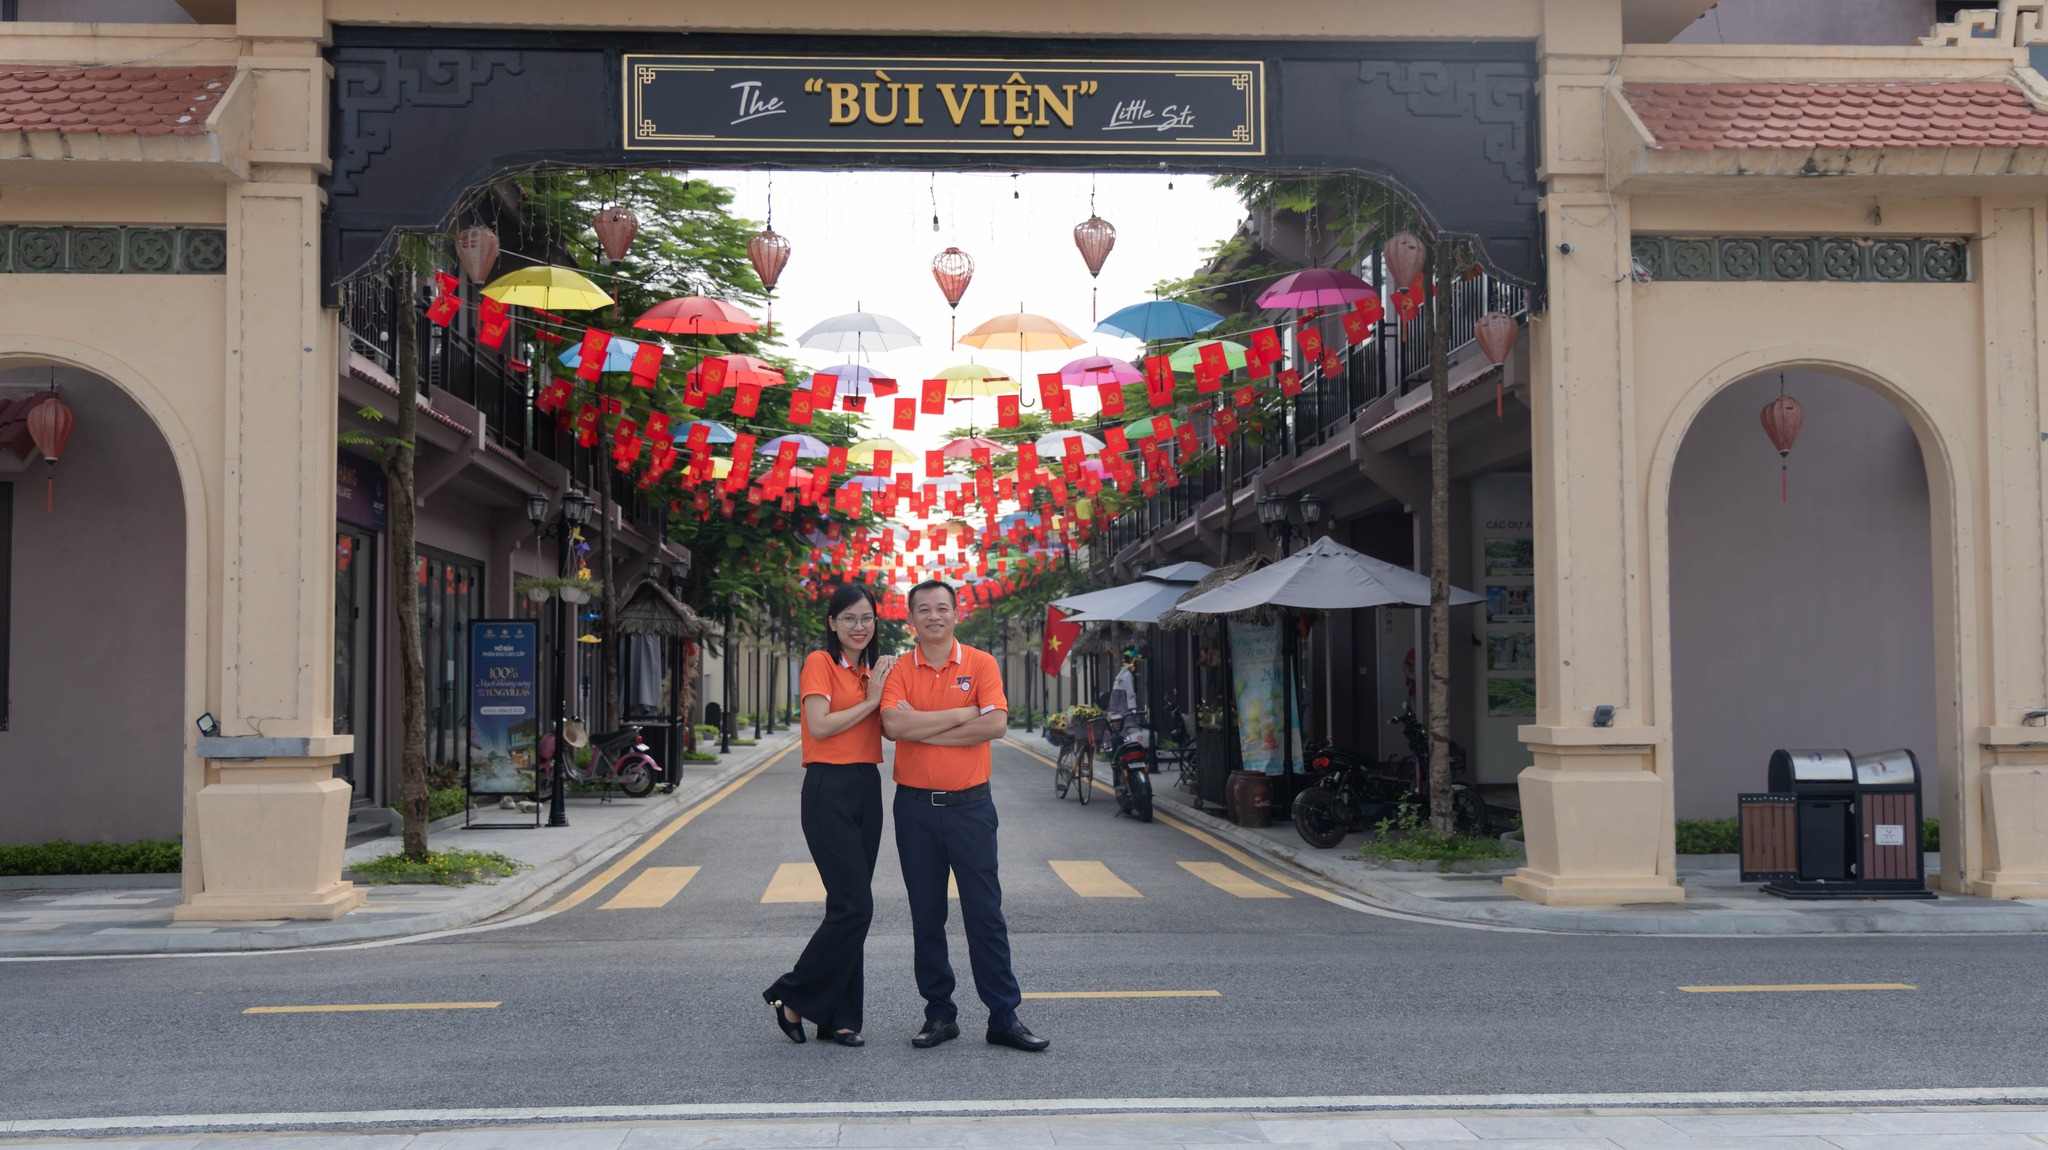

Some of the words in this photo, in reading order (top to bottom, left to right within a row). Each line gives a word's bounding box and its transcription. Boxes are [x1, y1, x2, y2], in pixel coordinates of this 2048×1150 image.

[730, 81, 786, 120] The
[1107, 99, 1155, 128] Little
[1156, 104, 1196, 132] Str
[1525, 518, 1533, 529] Á
[489, 667, 519, 679] 100%
